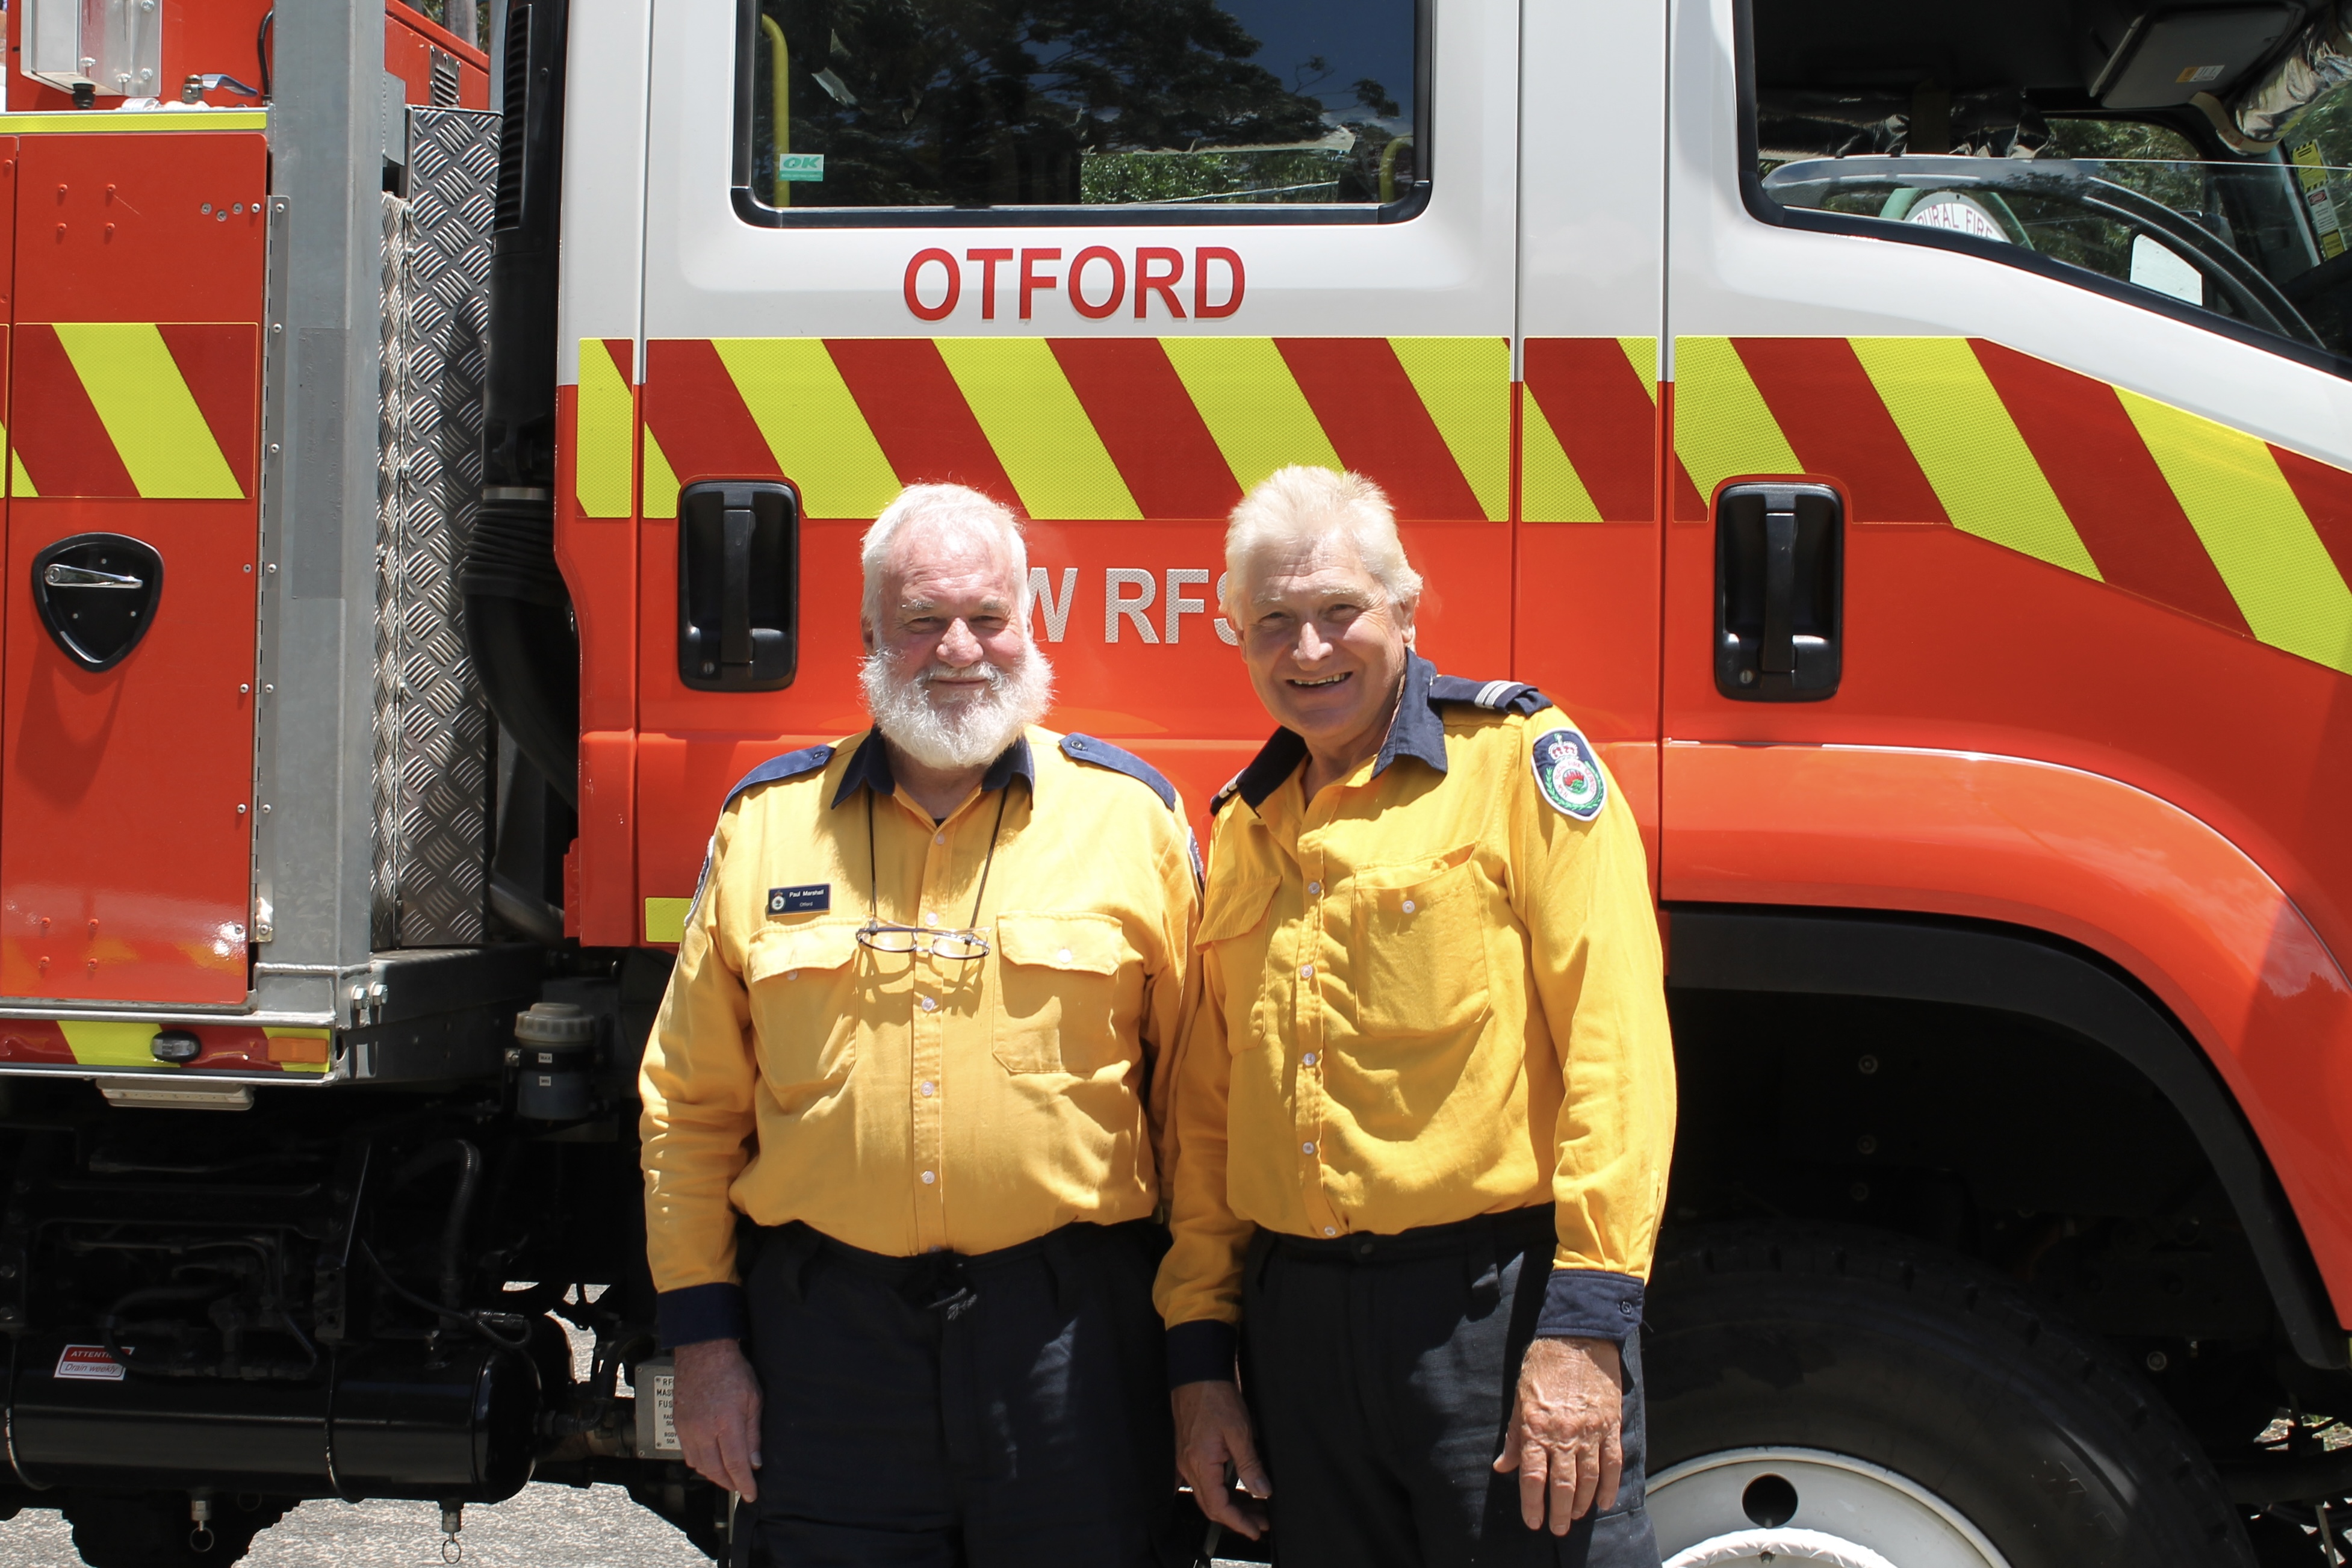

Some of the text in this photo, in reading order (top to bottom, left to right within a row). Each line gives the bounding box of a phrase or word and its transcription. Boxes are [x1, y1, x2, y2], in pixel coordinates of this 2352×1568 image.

[783, 156, 821, 169] OK
[904, 246, 1246, 321] OTFORD
[65, 1363, 119, 1374] Drain weekly
